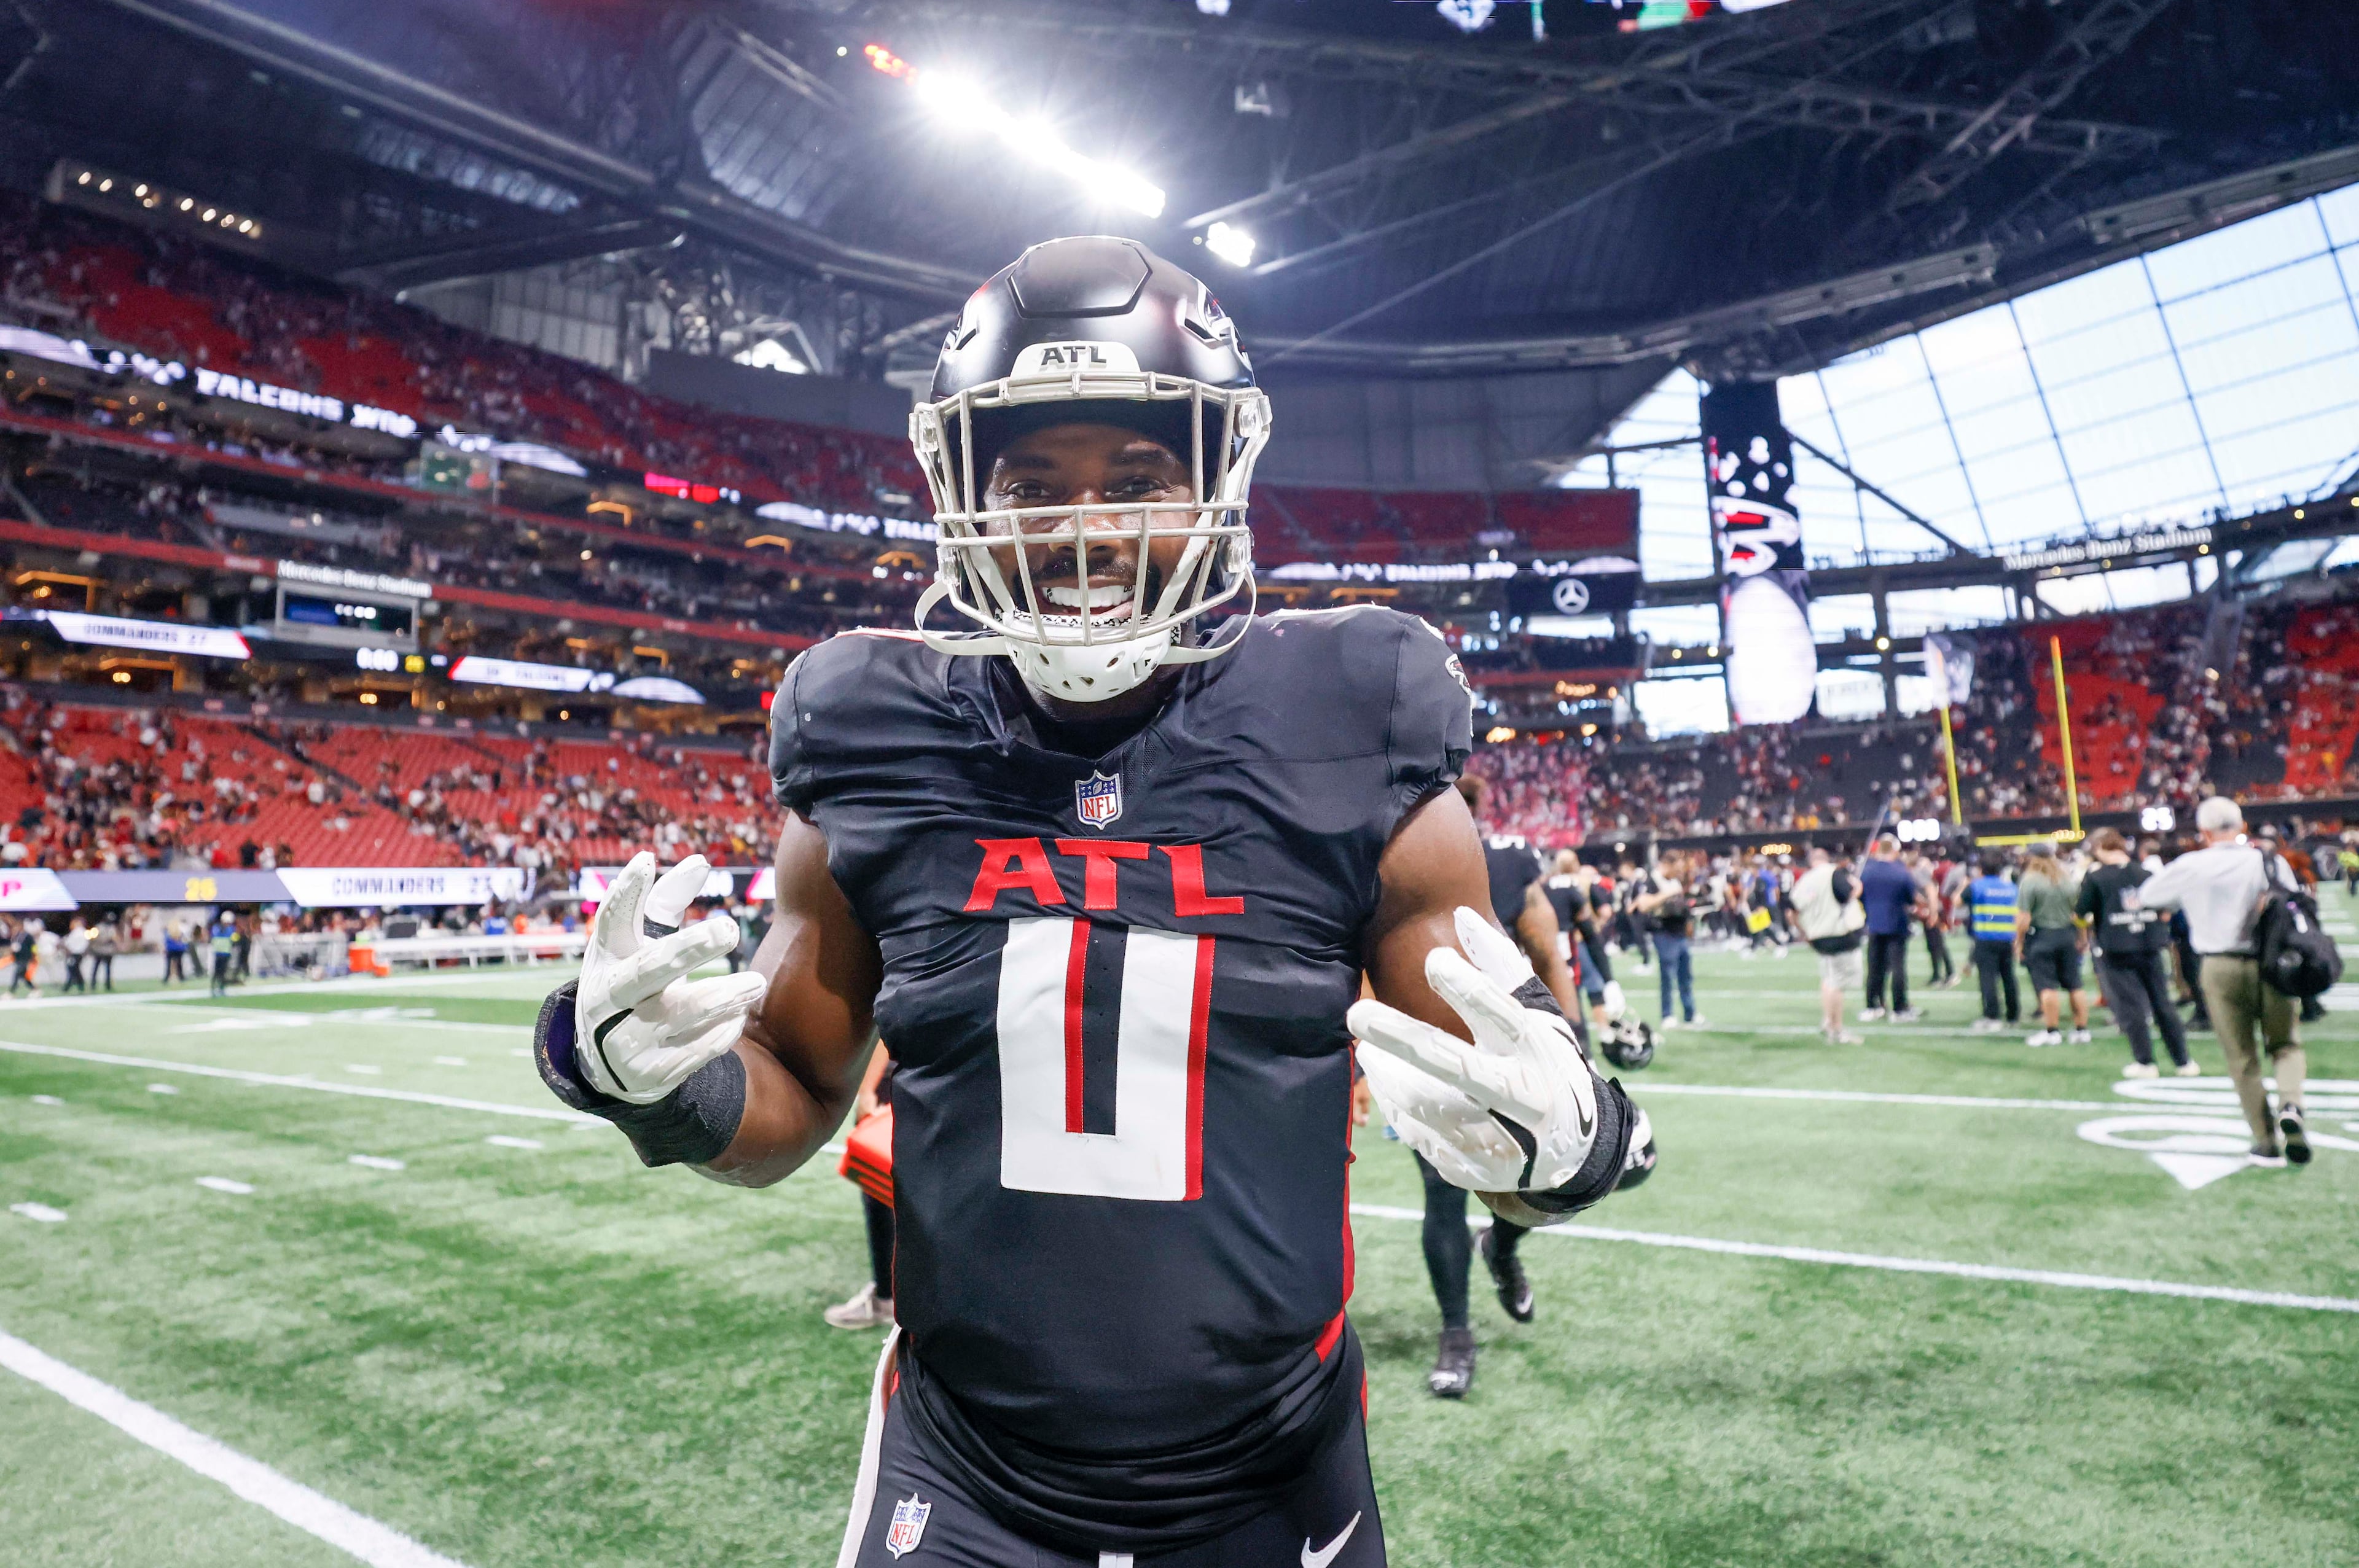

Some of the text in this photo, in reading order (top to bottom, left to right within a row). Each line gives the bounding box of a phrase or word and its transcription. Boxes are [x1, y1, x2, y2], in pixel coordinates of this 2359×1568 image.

[1041, 345, 1107, 366] ATL
[194, 367, 344, 422] FALCONS
[2132, 527, 2212, 552] Stadium
[377, 574, 432, 599] Stadium
[1083, 796, 1115, 819] NFL
[332, 876, 445, 895] COMMANDERS
[963, 837, 1245, 917] ATL
[891, 1523, 915, 1547] NFL
